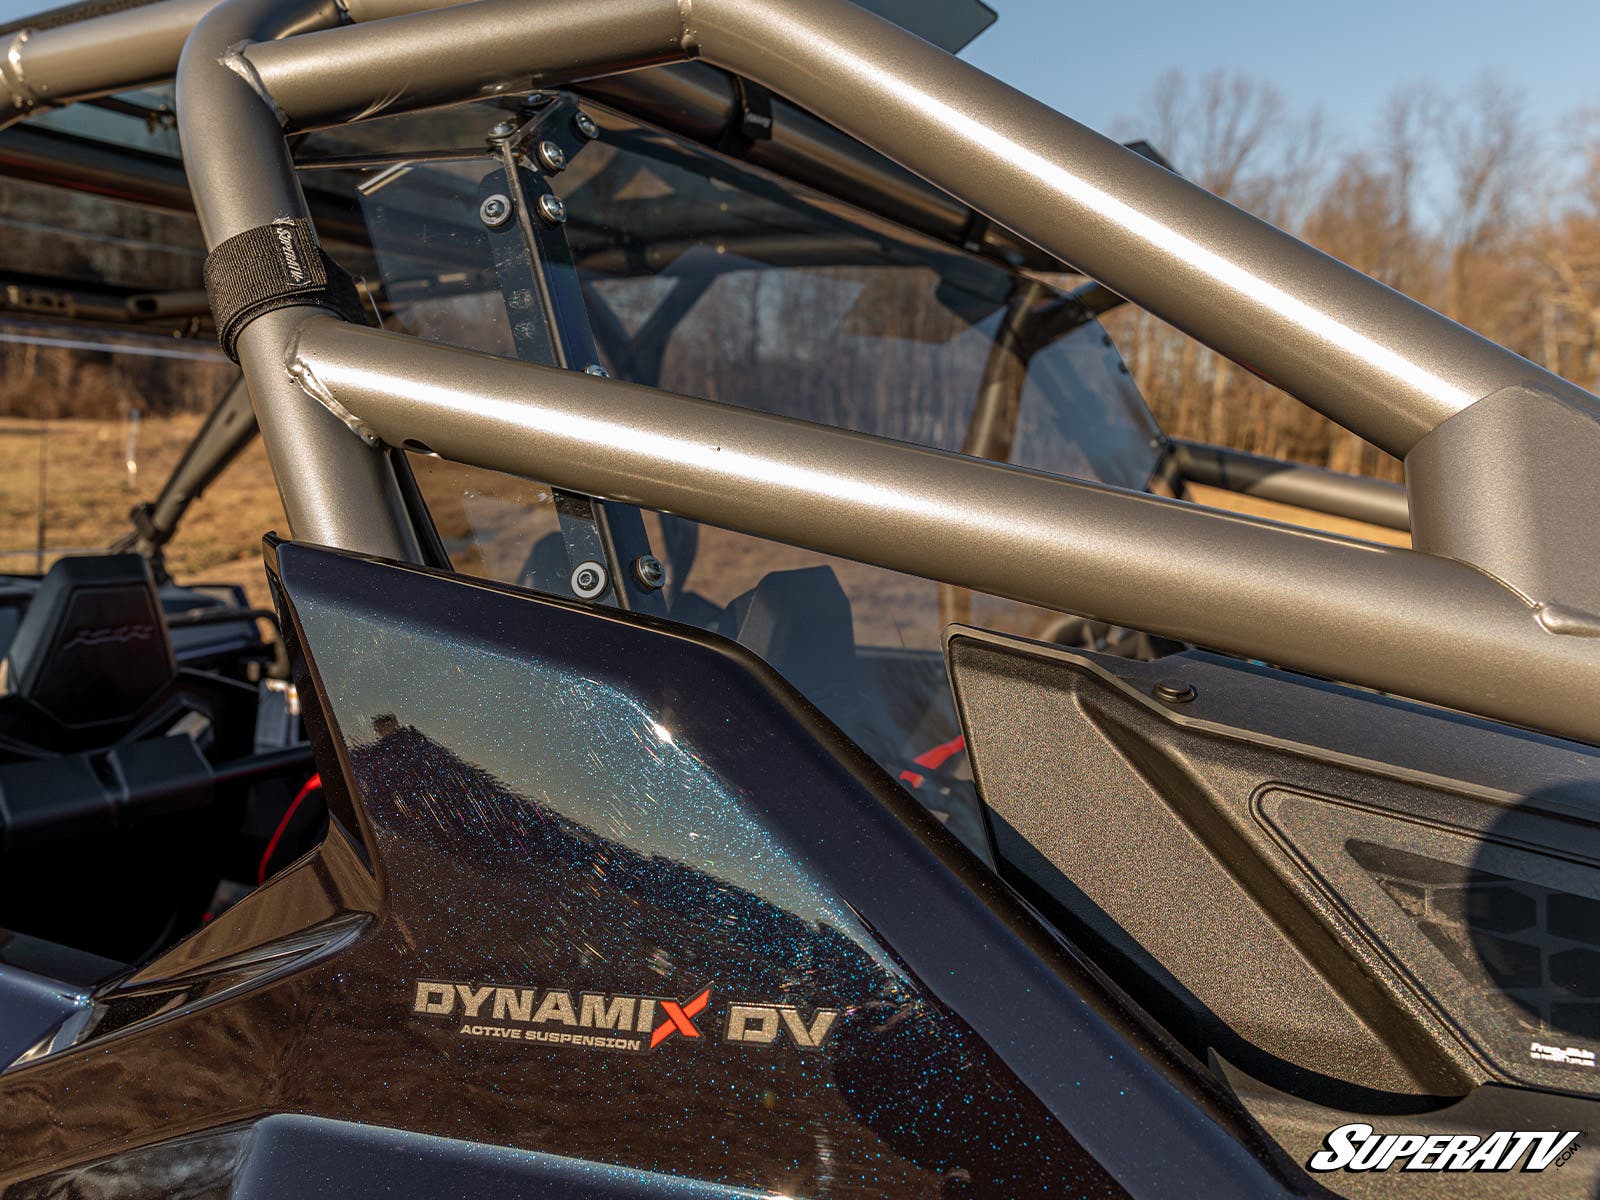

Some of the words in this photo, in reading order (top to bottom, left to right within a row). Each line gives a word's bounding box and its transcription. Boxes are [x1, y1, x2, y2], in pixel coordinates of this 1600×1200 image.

[414, 981, 711, 1049] DYNAMIX
[727, 1005, 838, 1047] DV
[460, 1025, 521, 1039] ACTIVE
[524, 1031, 640, 1051] SUSPENSION
